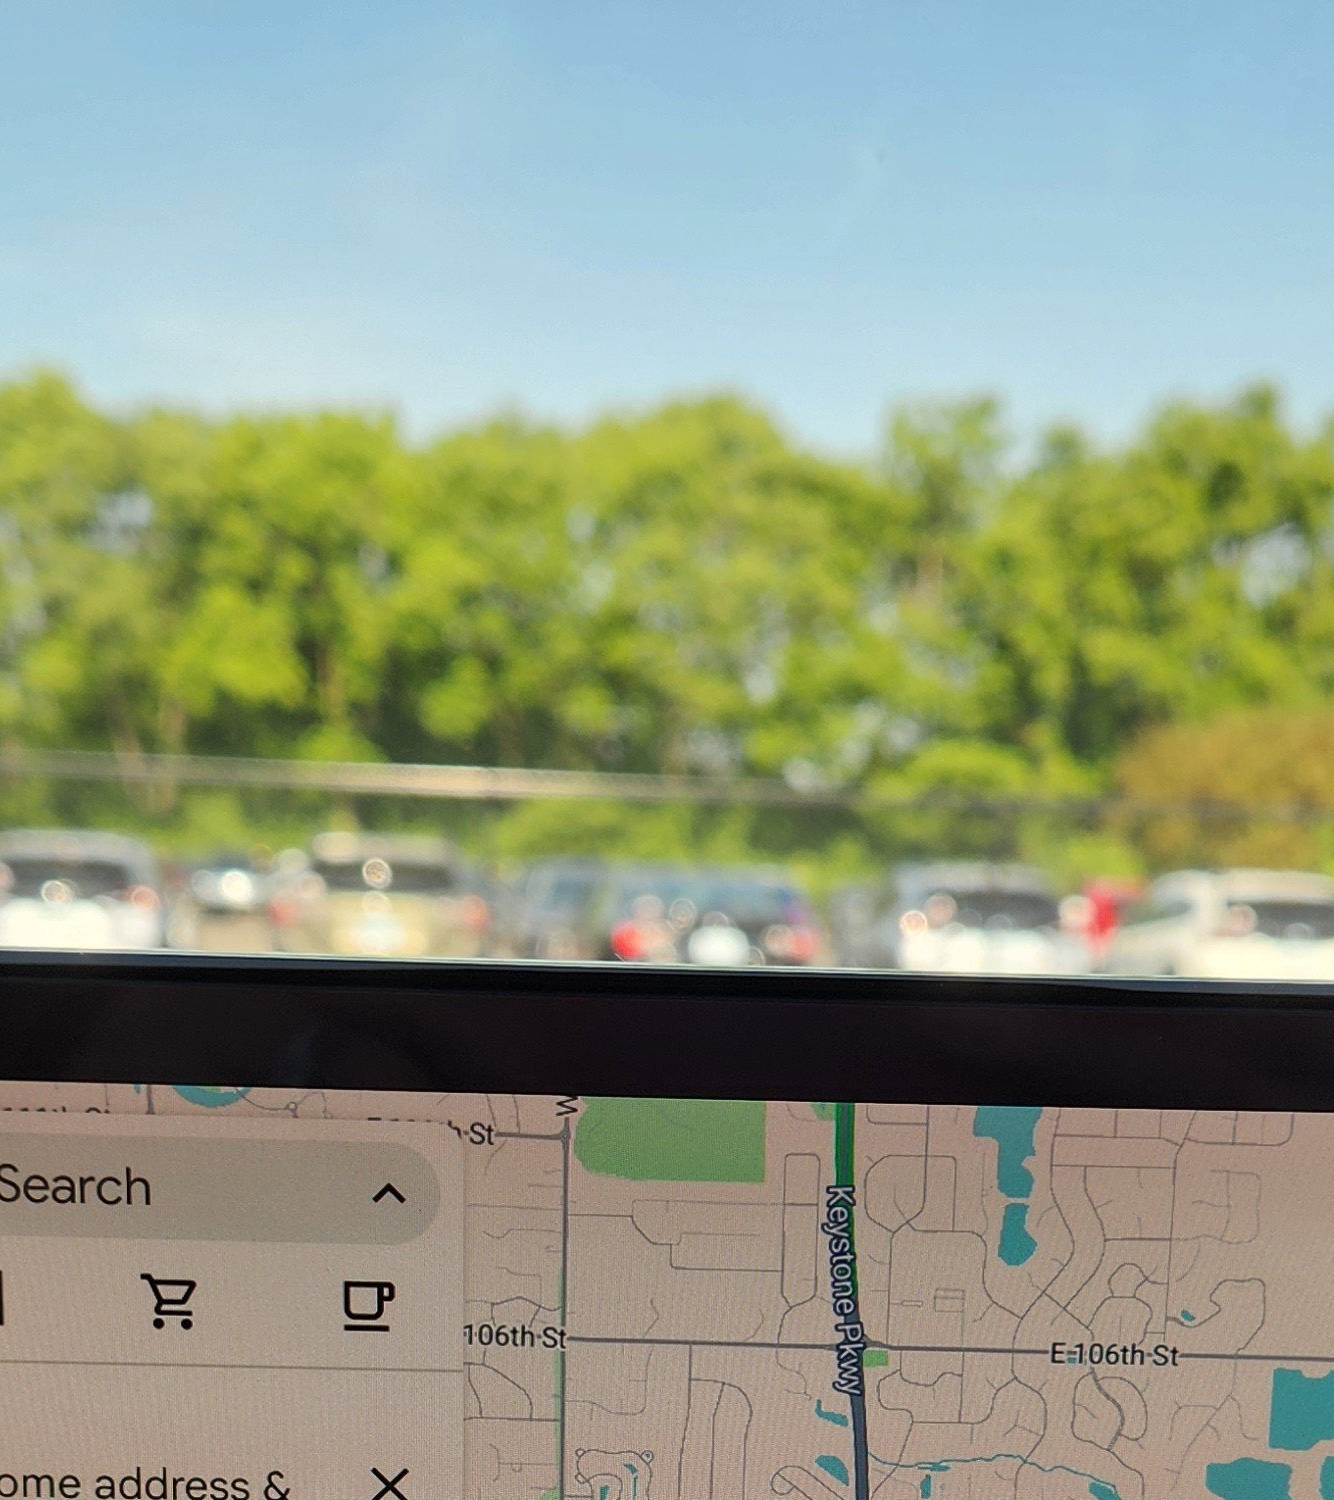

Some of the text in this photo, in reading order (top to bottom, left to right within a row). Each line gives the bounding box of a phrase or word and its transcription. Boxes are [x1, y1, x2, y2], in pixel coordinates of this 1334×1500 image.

[469, 1121, 495, 1146] St
[820, 1184, 864, 1395] Keystone Pkwy
[463, 1323, 566, 1349] 106th St
[1050, 1342, 1179, 1367] E 106th St
